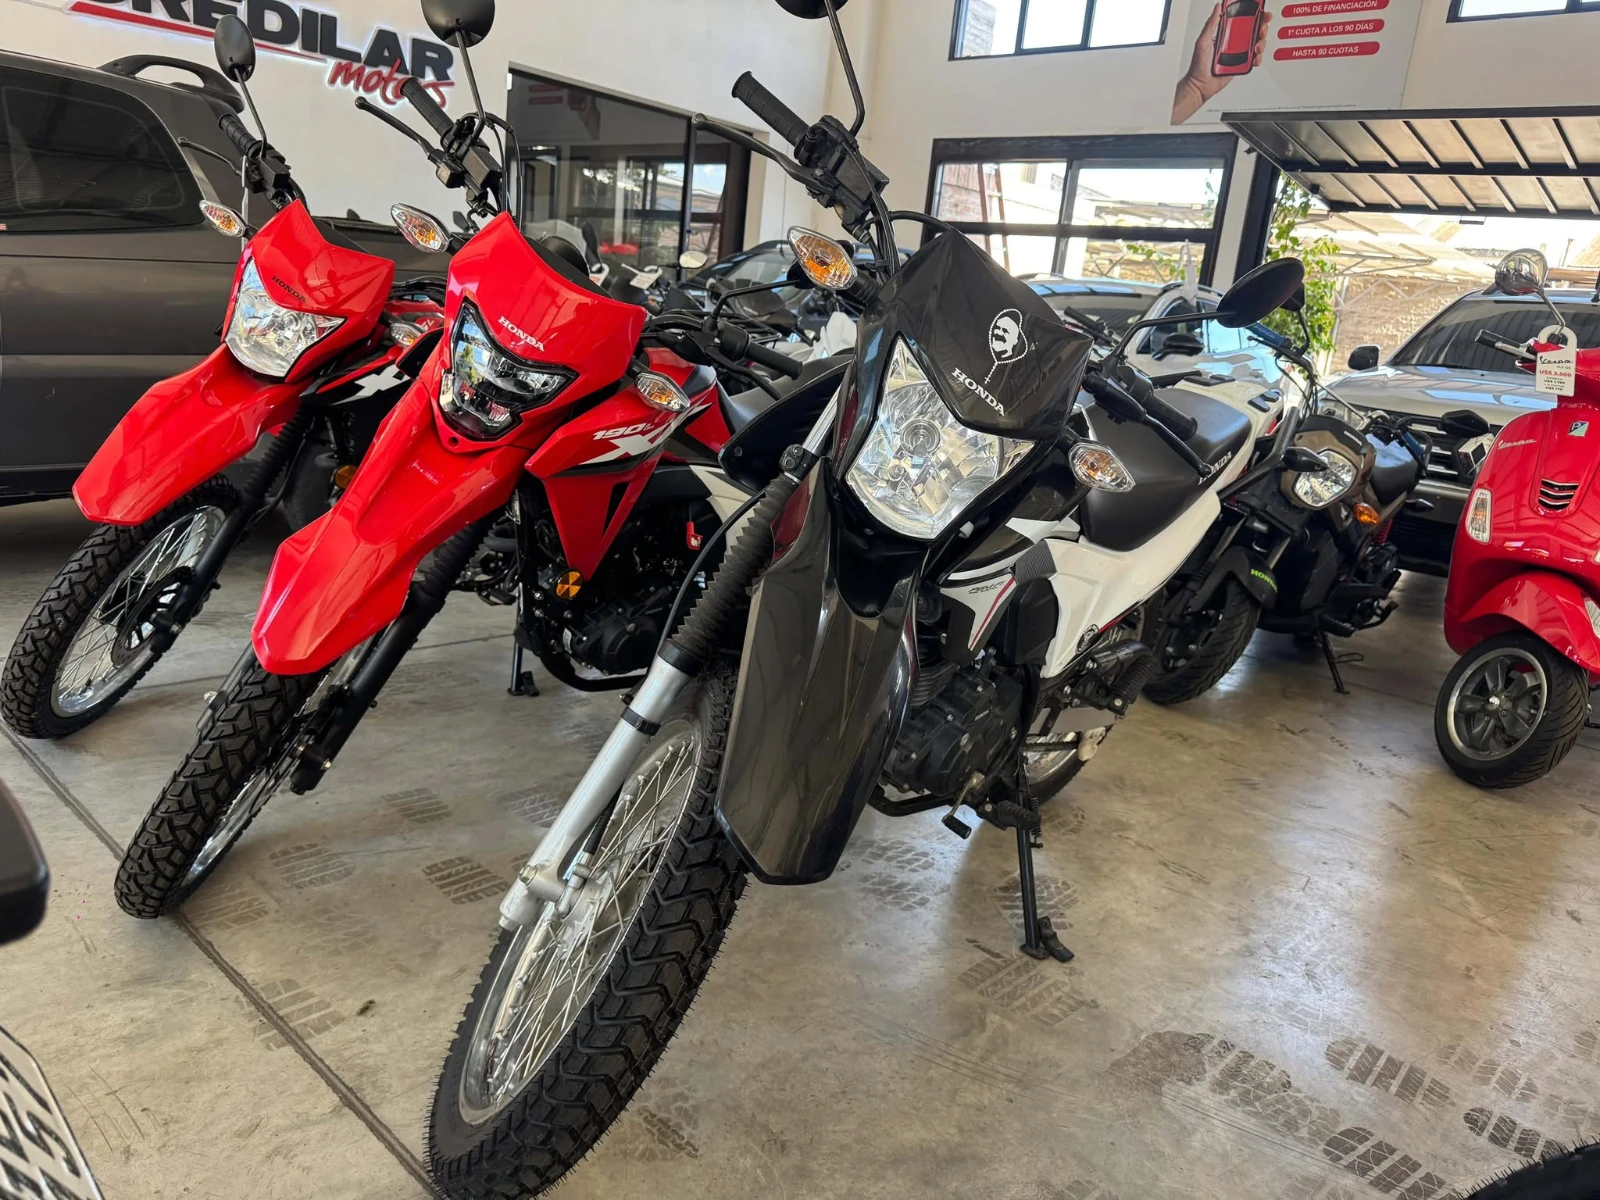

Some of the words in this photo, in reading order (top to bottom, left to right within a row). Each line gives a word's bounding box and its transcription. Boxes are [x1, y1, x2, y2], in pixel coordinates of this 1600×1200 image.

[1293, 6, 1311, 14] 100%
[1295, 27, 1320, 36] CUOTA
[1329, 25, 1343, 33] LOS
[78, 0, 453, 82] REDILAR
[1292, 49, 1317, 57] HASTA
[1328, 46, 1359, 55] CUOTAS
[272, 275, 306, 304] HONDA
[498, 315, 545, 352] HONDA
[1539, 356, 1573, 364] Vespa
[951, 367, 1005, 417] HONDA
[1498, 439, 1537, 450] Vespa
